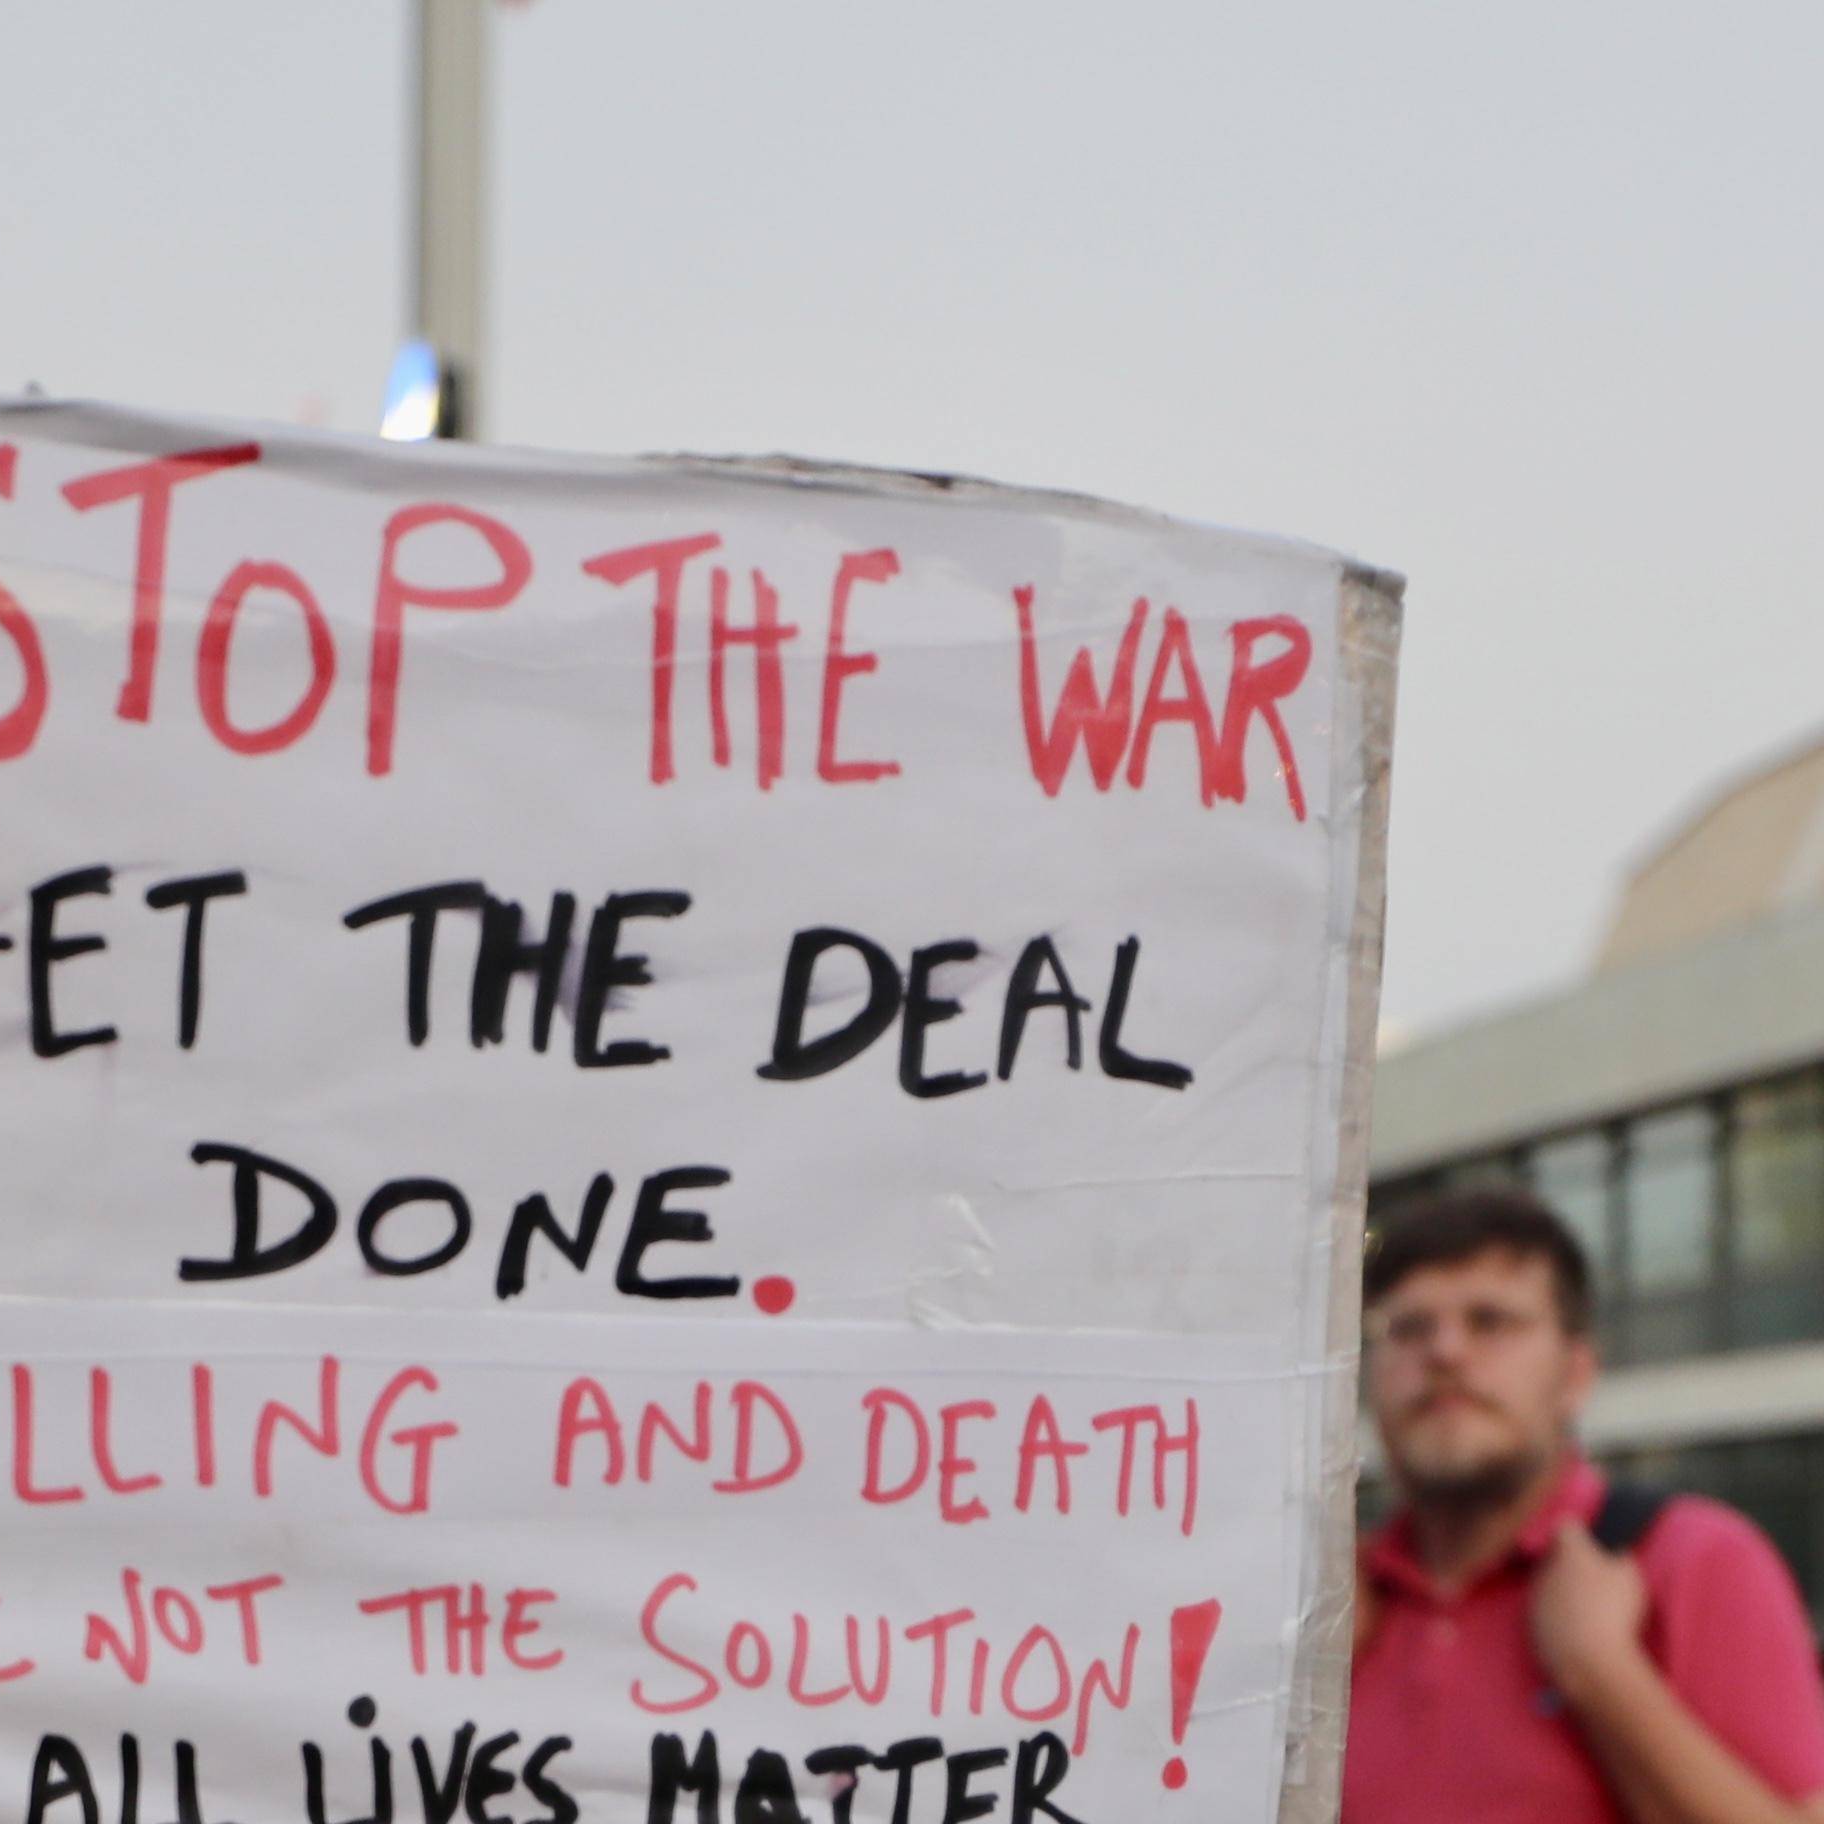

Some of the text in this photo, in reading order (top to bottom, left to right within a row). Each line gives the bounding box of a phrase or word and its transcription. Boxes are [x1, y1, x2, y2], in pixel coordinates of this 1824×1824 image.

[584, 535, 899, 789] THE
[1014, 587, 1311, 820] WAR
[344, 882, 690, 1067] THE
[757, 929, 1192, 1098] DEAL
[179, 1144, 795, 1314] DONE.
[555, 1379, 802, 1493] AND
[862, 1389, 1198, 1534] DEATH
[86, 1570, 281, 1683] NOT
[360, 1585, 562, 1674] THE
[632, 1575, 1220, 1789] SOLUTION!
